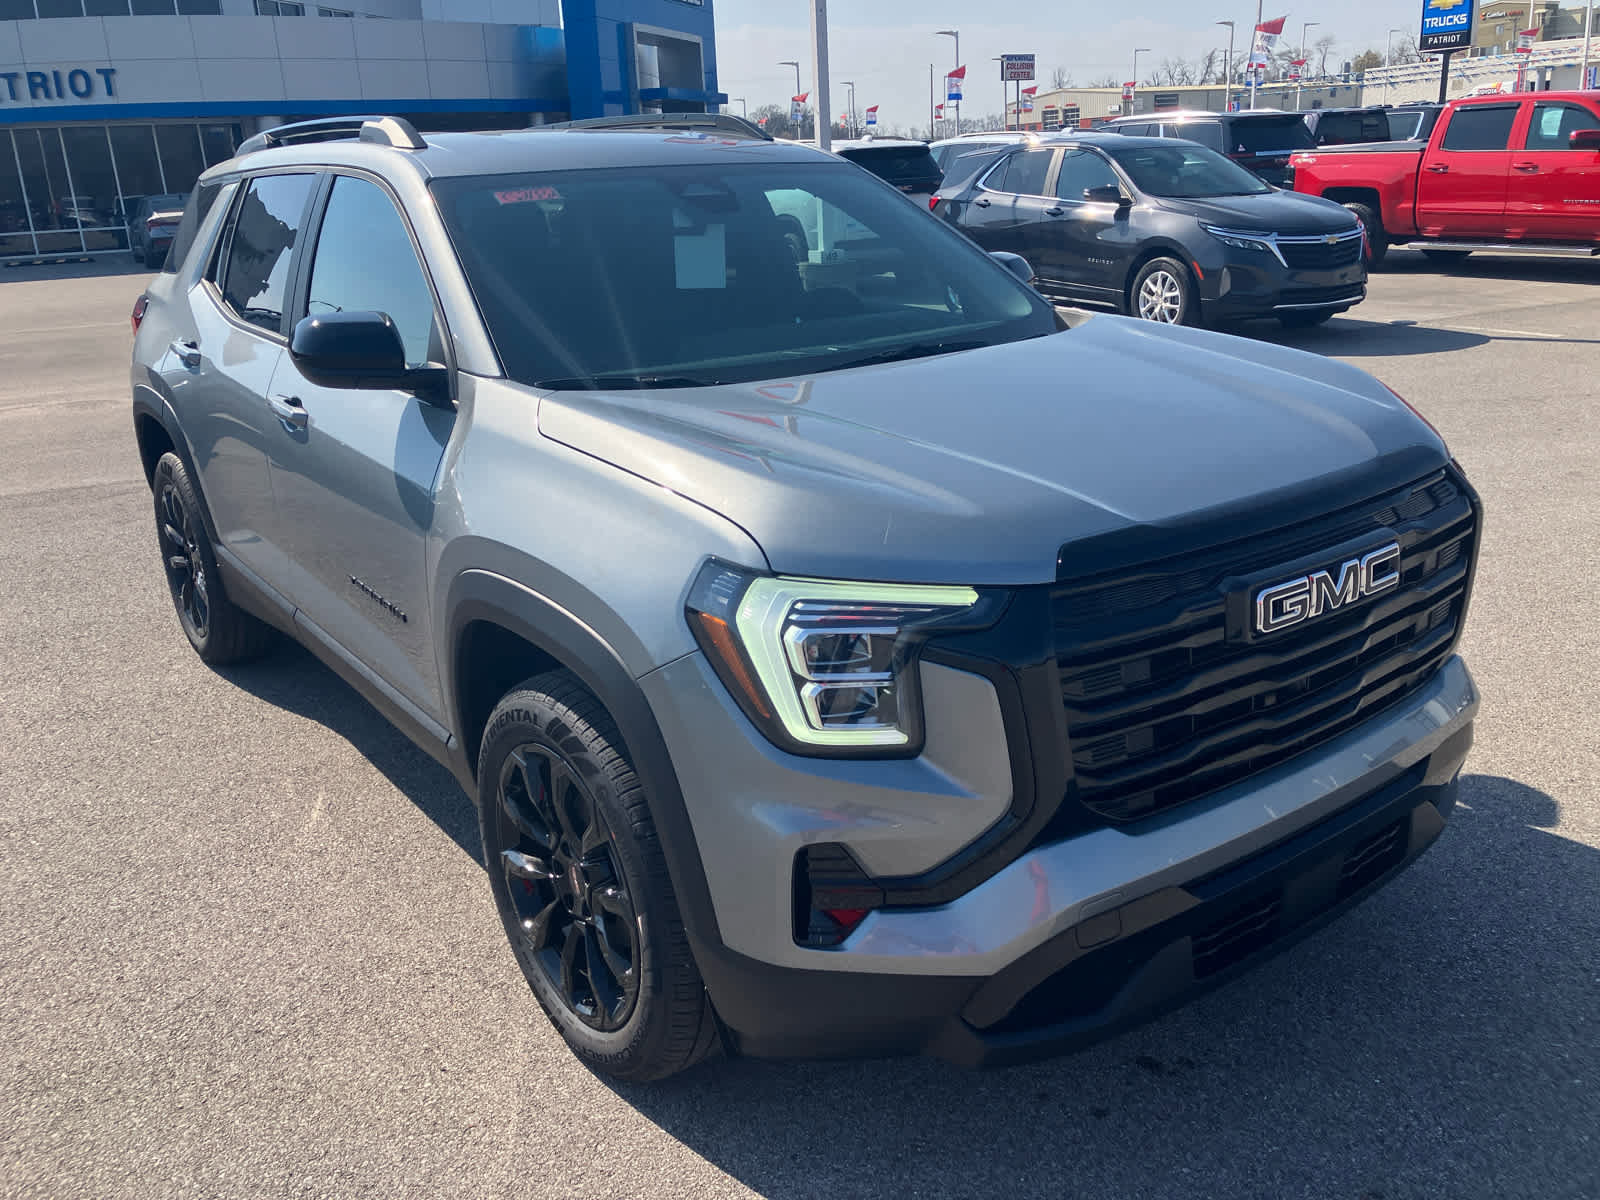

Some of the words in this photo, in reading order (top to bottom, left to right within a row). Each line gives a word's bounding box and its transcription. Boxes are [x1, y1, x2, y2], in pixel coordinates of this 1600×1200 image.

[1424, 13, 1467, 28] TRUCKS
[1428, 34, 1461, 45] PATRIOT
[1006, 62, 1034, 70] COLLISION
[1009, 71, 1031, 79] CENTER
[1256, 542, 1400, 633] GMC
